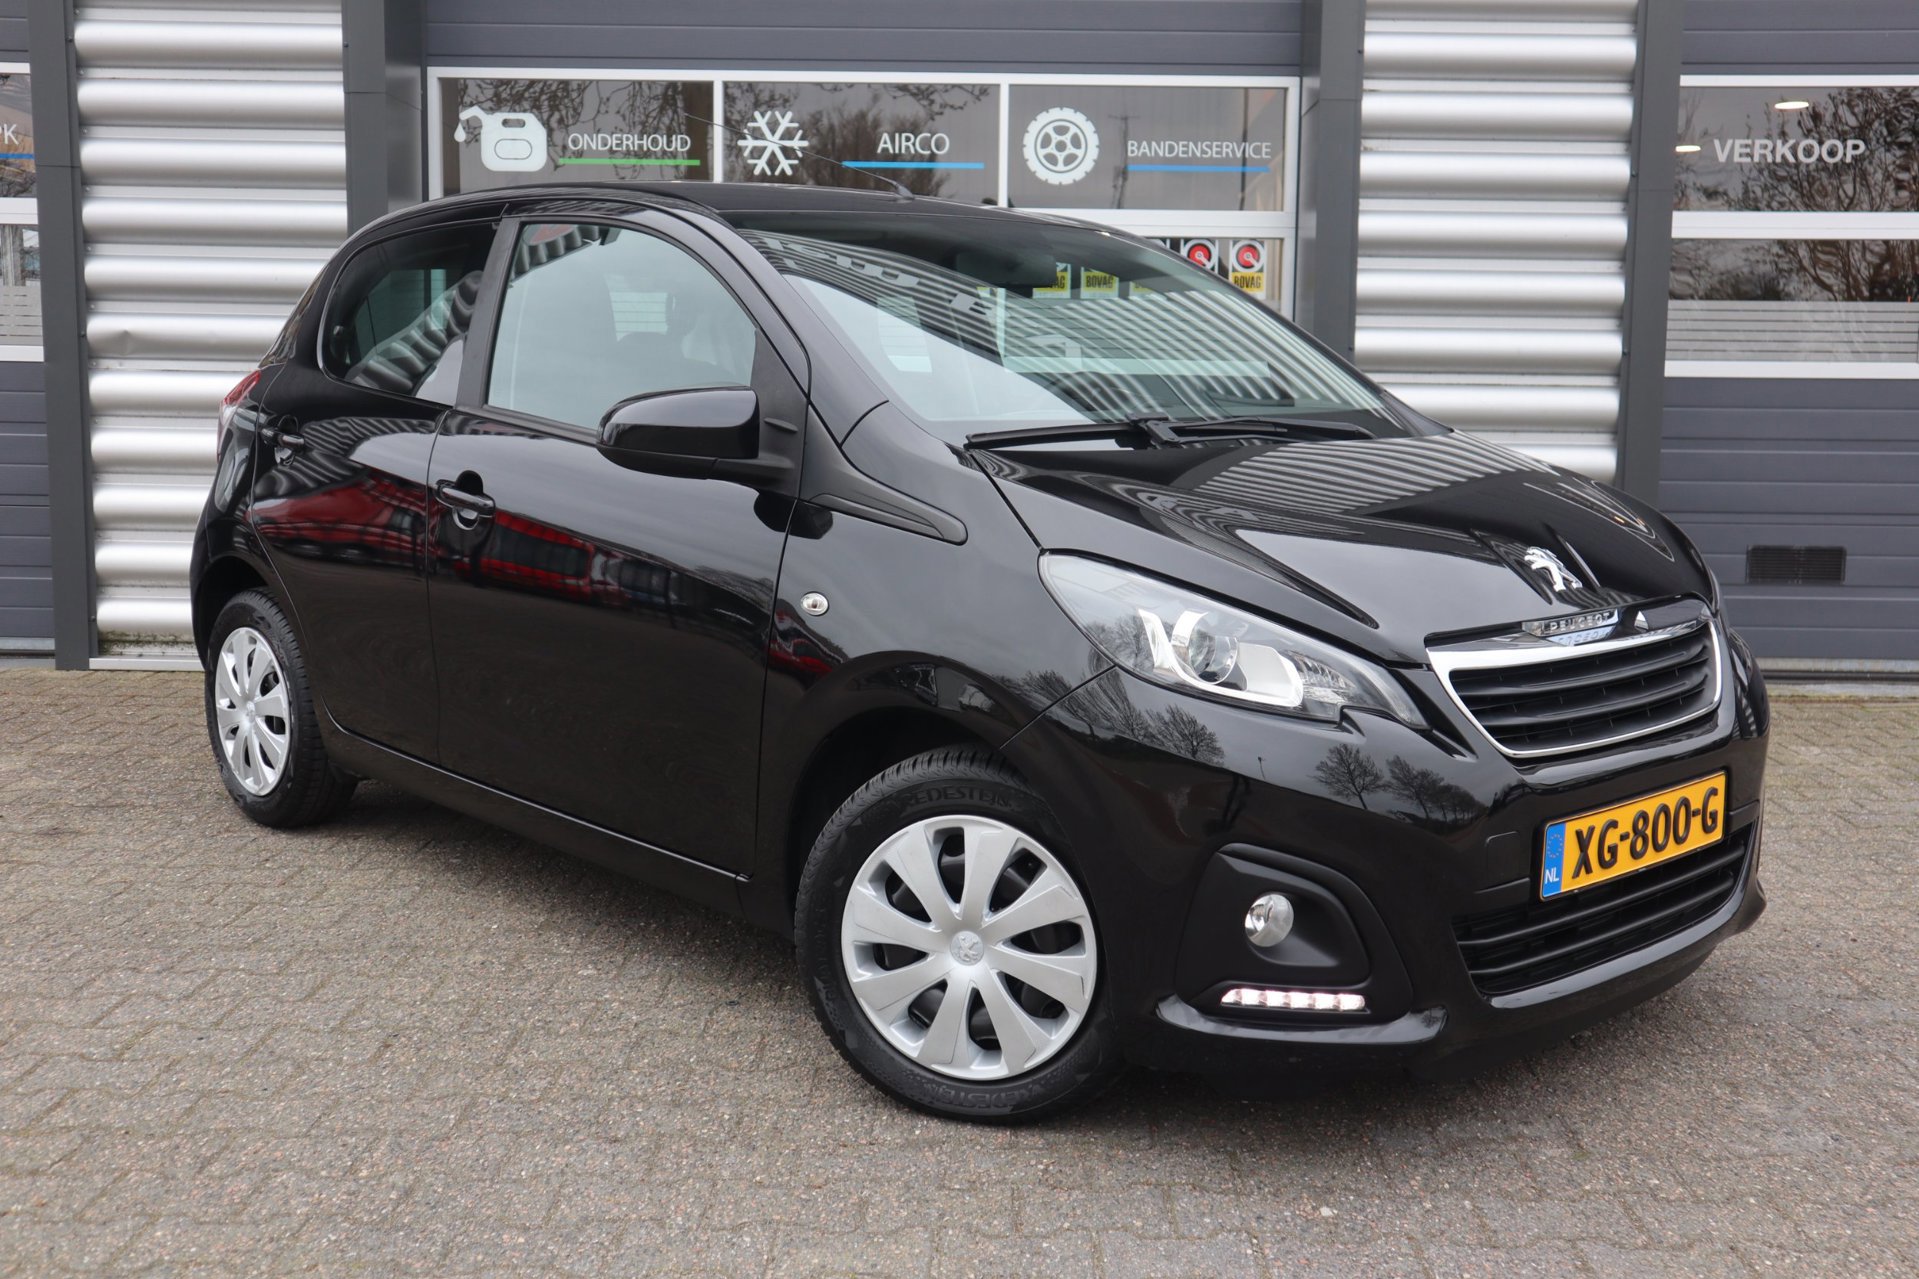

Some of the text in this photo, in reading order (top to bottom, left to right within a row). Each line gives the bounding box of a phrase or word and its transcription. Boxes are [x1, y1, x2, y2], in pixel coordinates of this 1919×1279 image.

[567, 132, 692, 153] ONDERHOUD
[876, 131, 951, 156] AIRCO
[1126, 139, 1272, 160] BANDENSERVICE
[1713, 138, 1866, 164] VERKOOP
[1085, 275, 1114, 289] BOVAG
[1233, 275, 1262, 289] BOVAG
[1549, 611, 1610, 632] PEUGEOT
[1571, 786, 1719, 880] XG-800-G
[1544, 866, 1560, 885] NL
